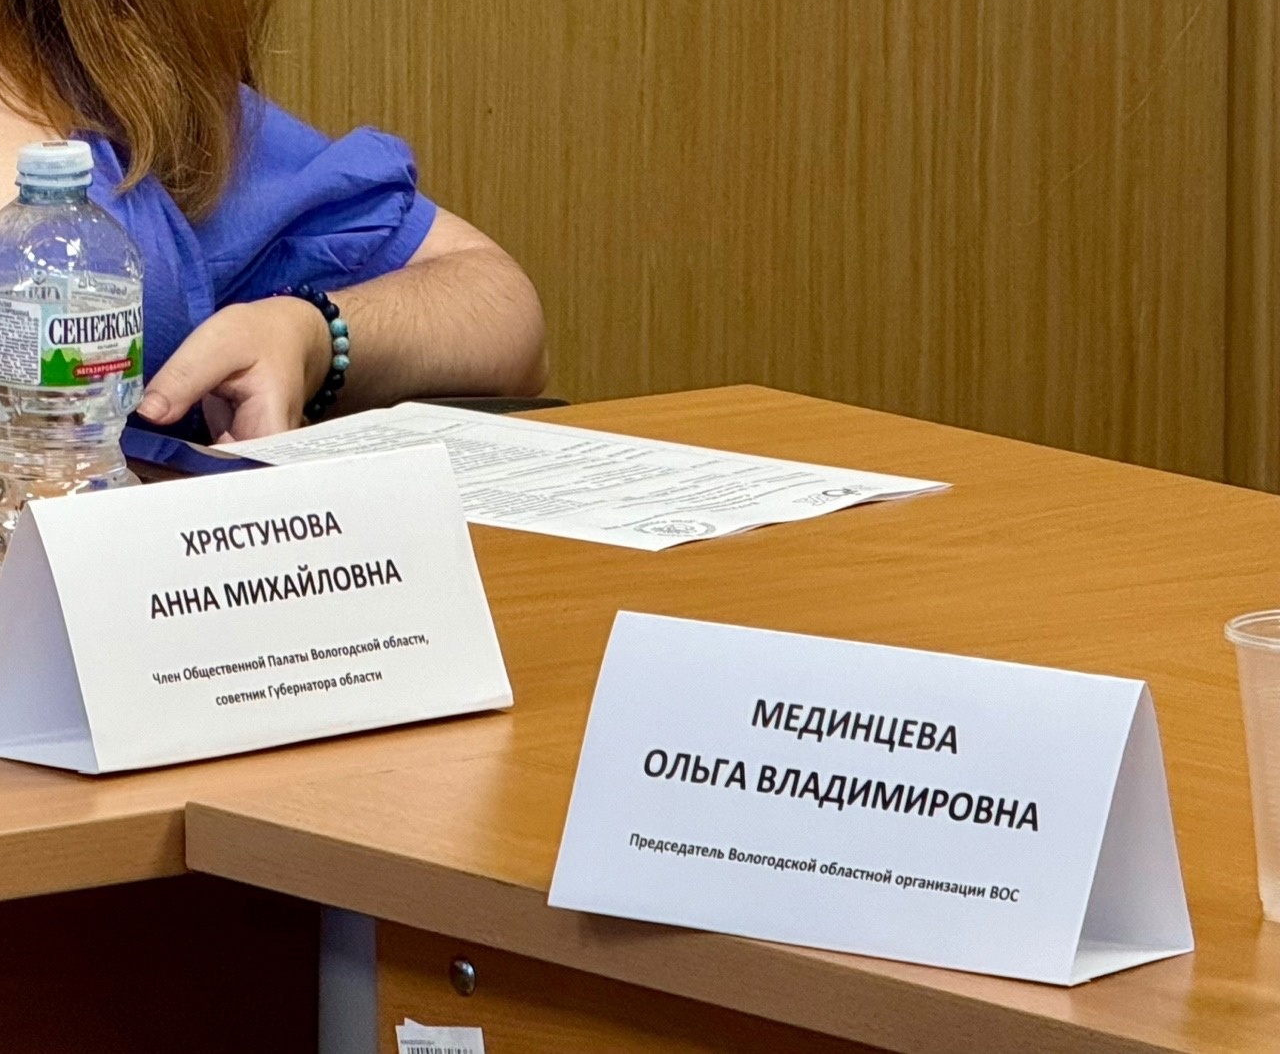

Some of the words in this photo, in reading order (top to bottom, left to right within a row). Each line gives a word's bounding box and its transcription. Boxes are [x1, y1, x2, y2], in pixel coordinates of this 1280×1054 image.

[180, 511, 342, 556] ХРЯСТУНОВА
[151, 586, 220, 619] АННА
[224, 559, 402, 608] МИХАЙЛОВНА
[152, 671, 181, 685] Член
[183, 655, 266, 680] Общественной
[268, 650, 309, 668] Палаты
[311, 638, 381, 662] Вологодской
[383, 633, 430, 651] области,
[216, 688, 266, 706] советник
[268, 677, 337, 699] Губернатора
[340, 670, 383, 686] области
[752, 699, 958, 754] МЕДИНЦЕВА
[644, 749, 746, 790] ОЛЬГА
[757, 765, 1038, 831] ВЛАДИМИРОВНА
[629, 833, 725, 859] Председатель
[728, 848, 817, 874] Вологодской
[820, 862, 892, 884] областной
[895, 875, 986, 898] организации
[990, 886, 1020, 903] ВОС
